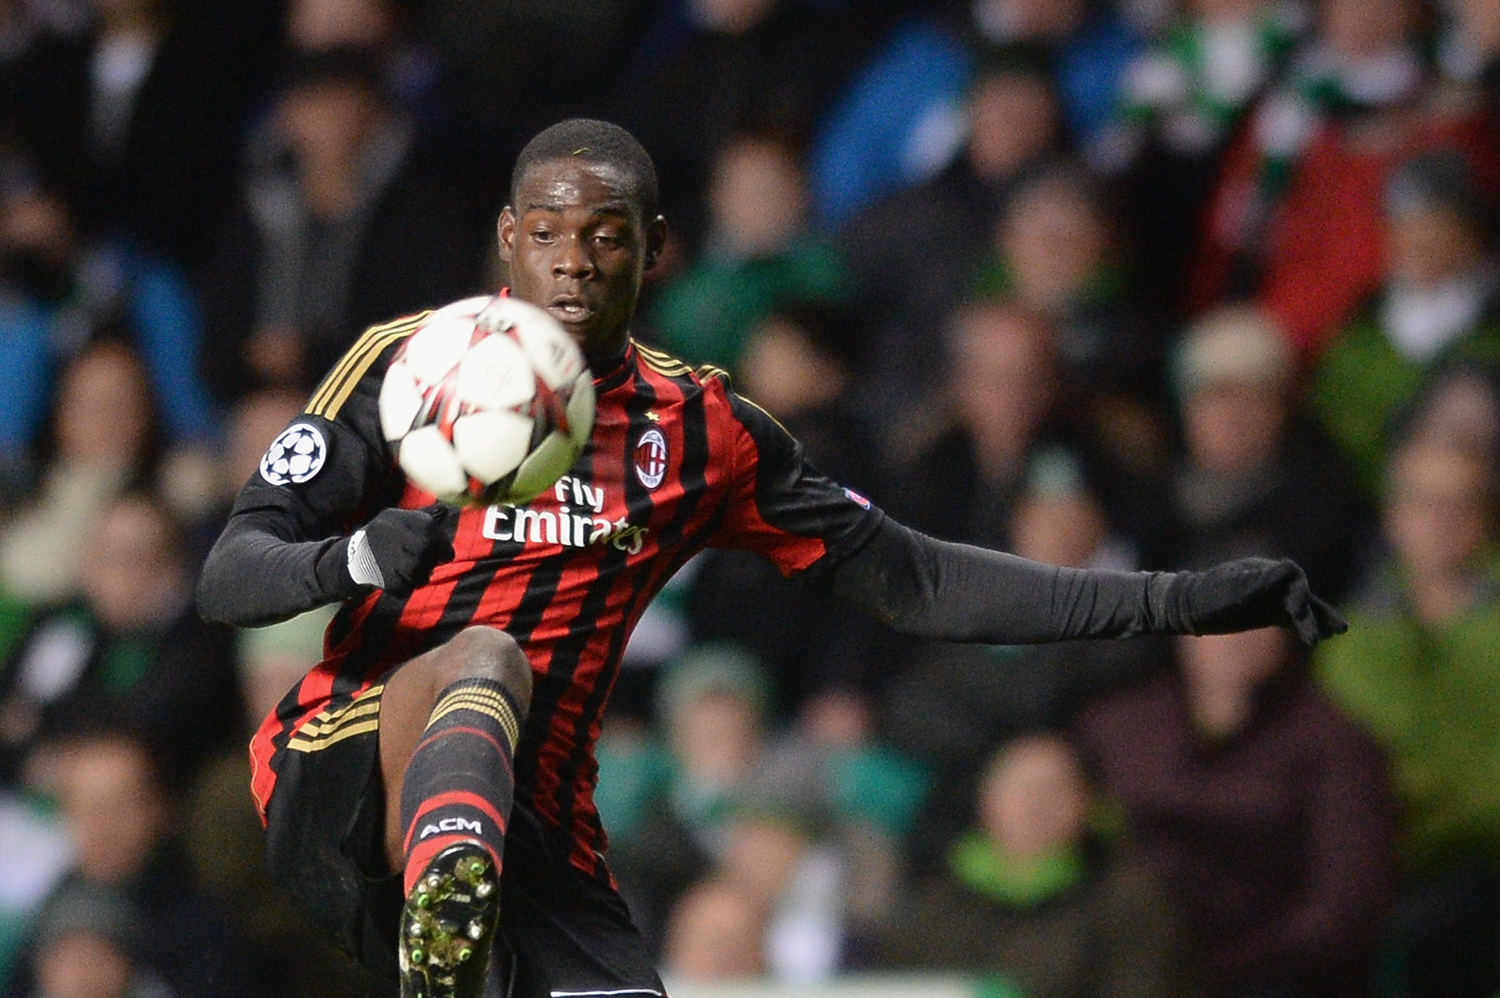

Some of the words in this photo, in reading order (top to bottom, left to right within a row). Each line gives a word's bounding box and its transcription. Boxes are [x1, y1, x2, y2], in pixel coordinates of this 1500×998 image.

[554, 475, 604, 513] Fly
[482, 502, 649, 555] Emirates
[420, 817, 482, 839] ACM
